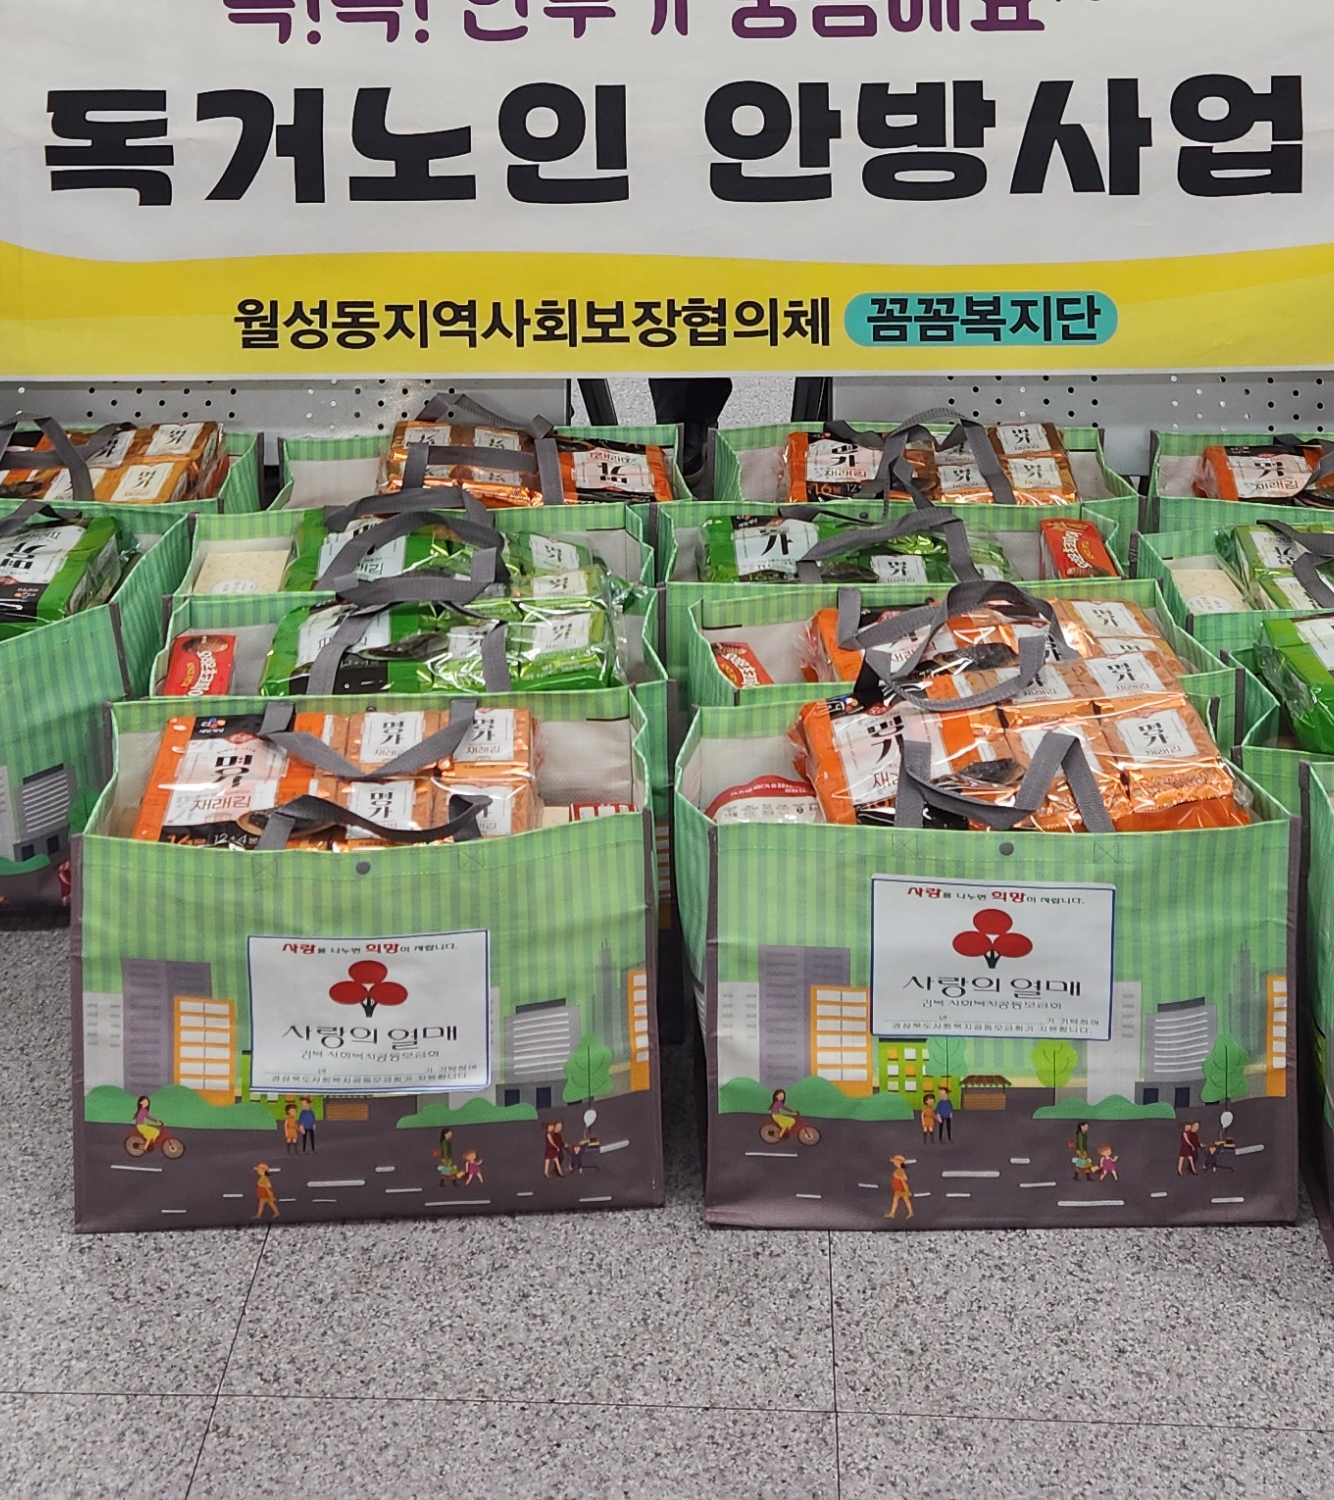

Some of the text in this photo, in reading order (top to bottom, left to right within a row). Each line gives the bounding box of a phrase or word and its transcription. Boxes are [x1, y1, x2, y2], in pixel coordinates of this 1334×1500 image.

[45, 74, 1303, 206] 독거노인 안방사업
[234, 295, 1102, 350] 월성동지역사회보장협의체 꼼꼼복지단
[381, 720, 404, 745] 명가
[1138, 722, 1170, 747] 명가
[192, 795, 251, 811] 재래김
[368, 791, 393, 818] 명가
[903, 975, 1081, 999] 사랑의 열매
[282, 1025, 457, 1050] 사랑의 열매
